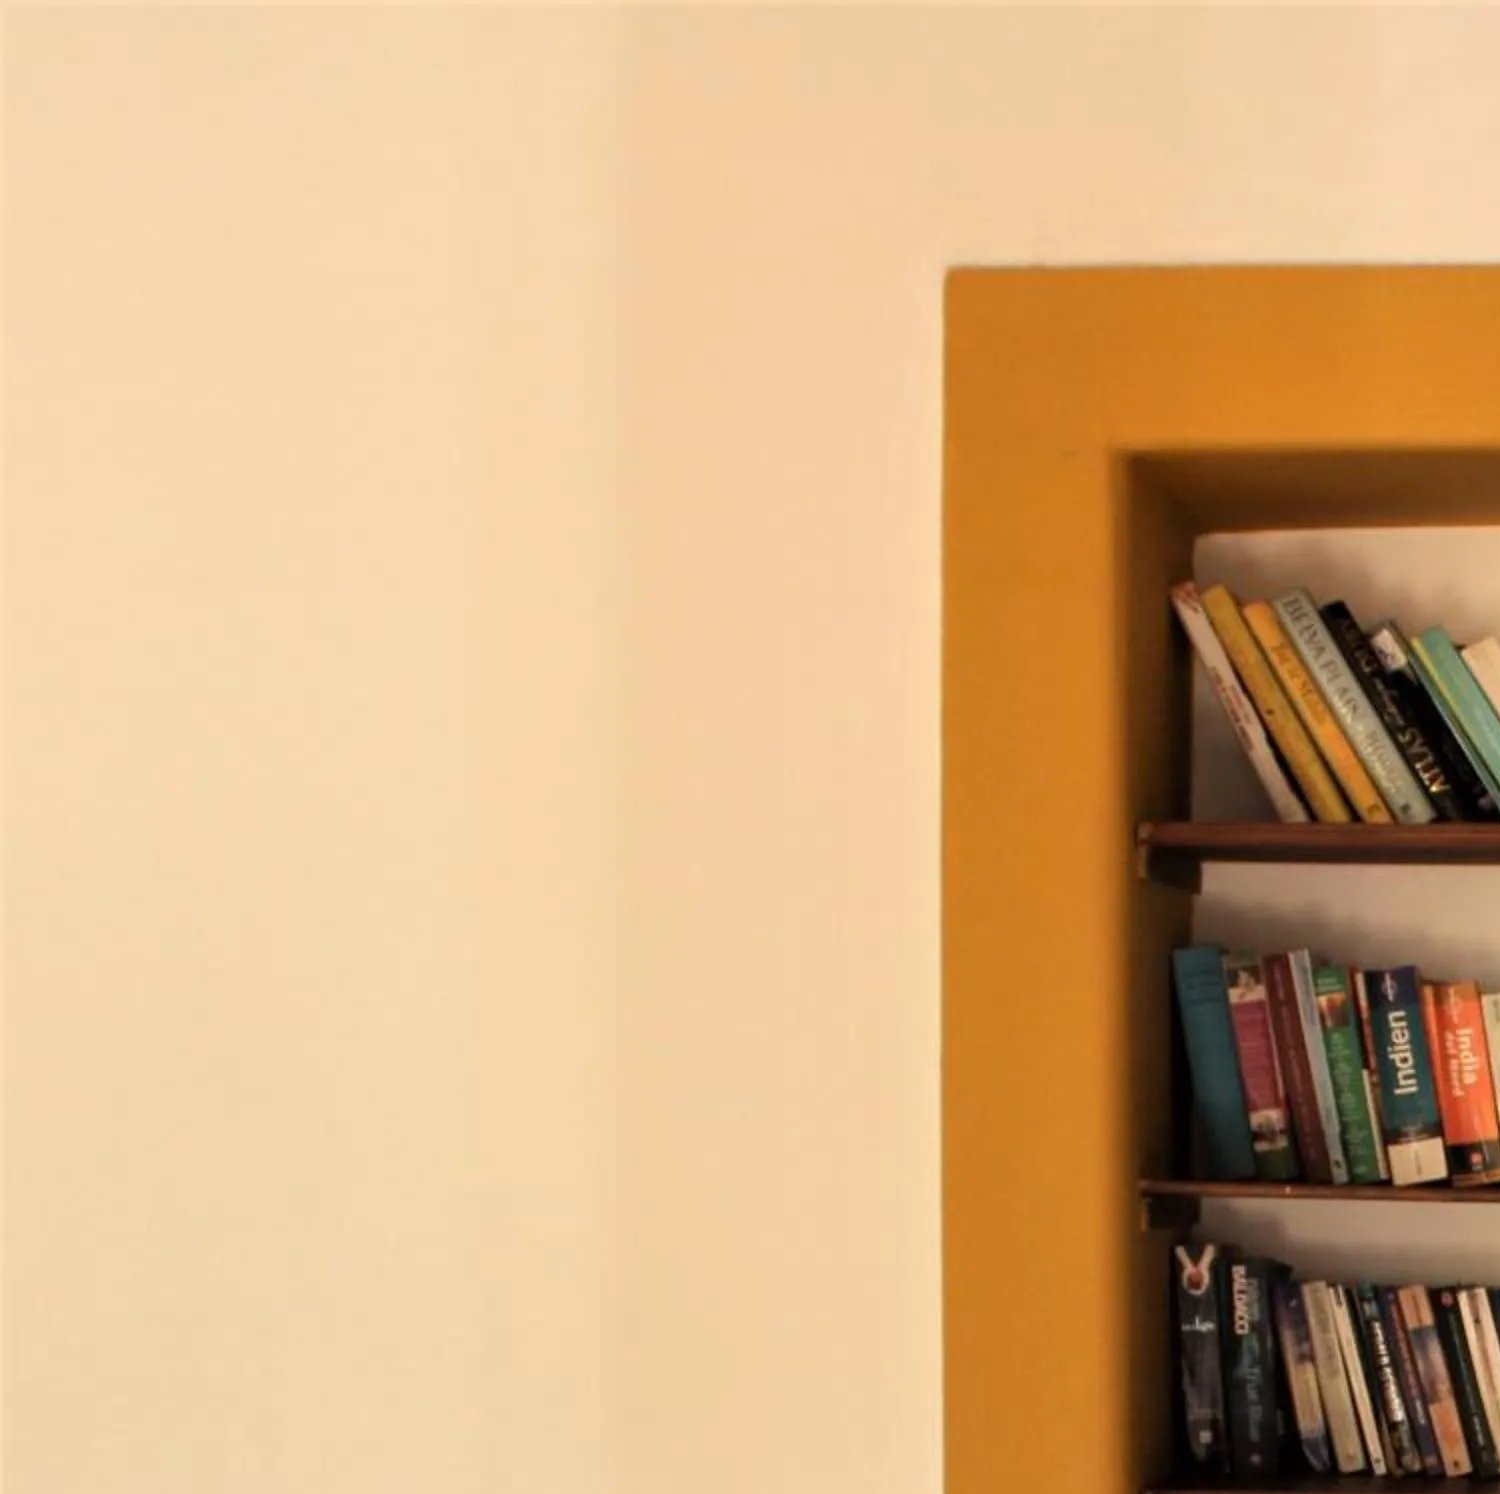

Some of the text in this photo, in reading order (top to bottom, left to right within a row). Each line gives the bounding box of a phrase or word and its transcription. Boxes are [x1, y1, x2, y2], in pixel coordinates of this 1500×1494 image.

[1396, 725, 1450, 797] ATLAS
[1383, 1009, 1418, 1095] Indien
[1455, 1027, 1480, 1084] India
